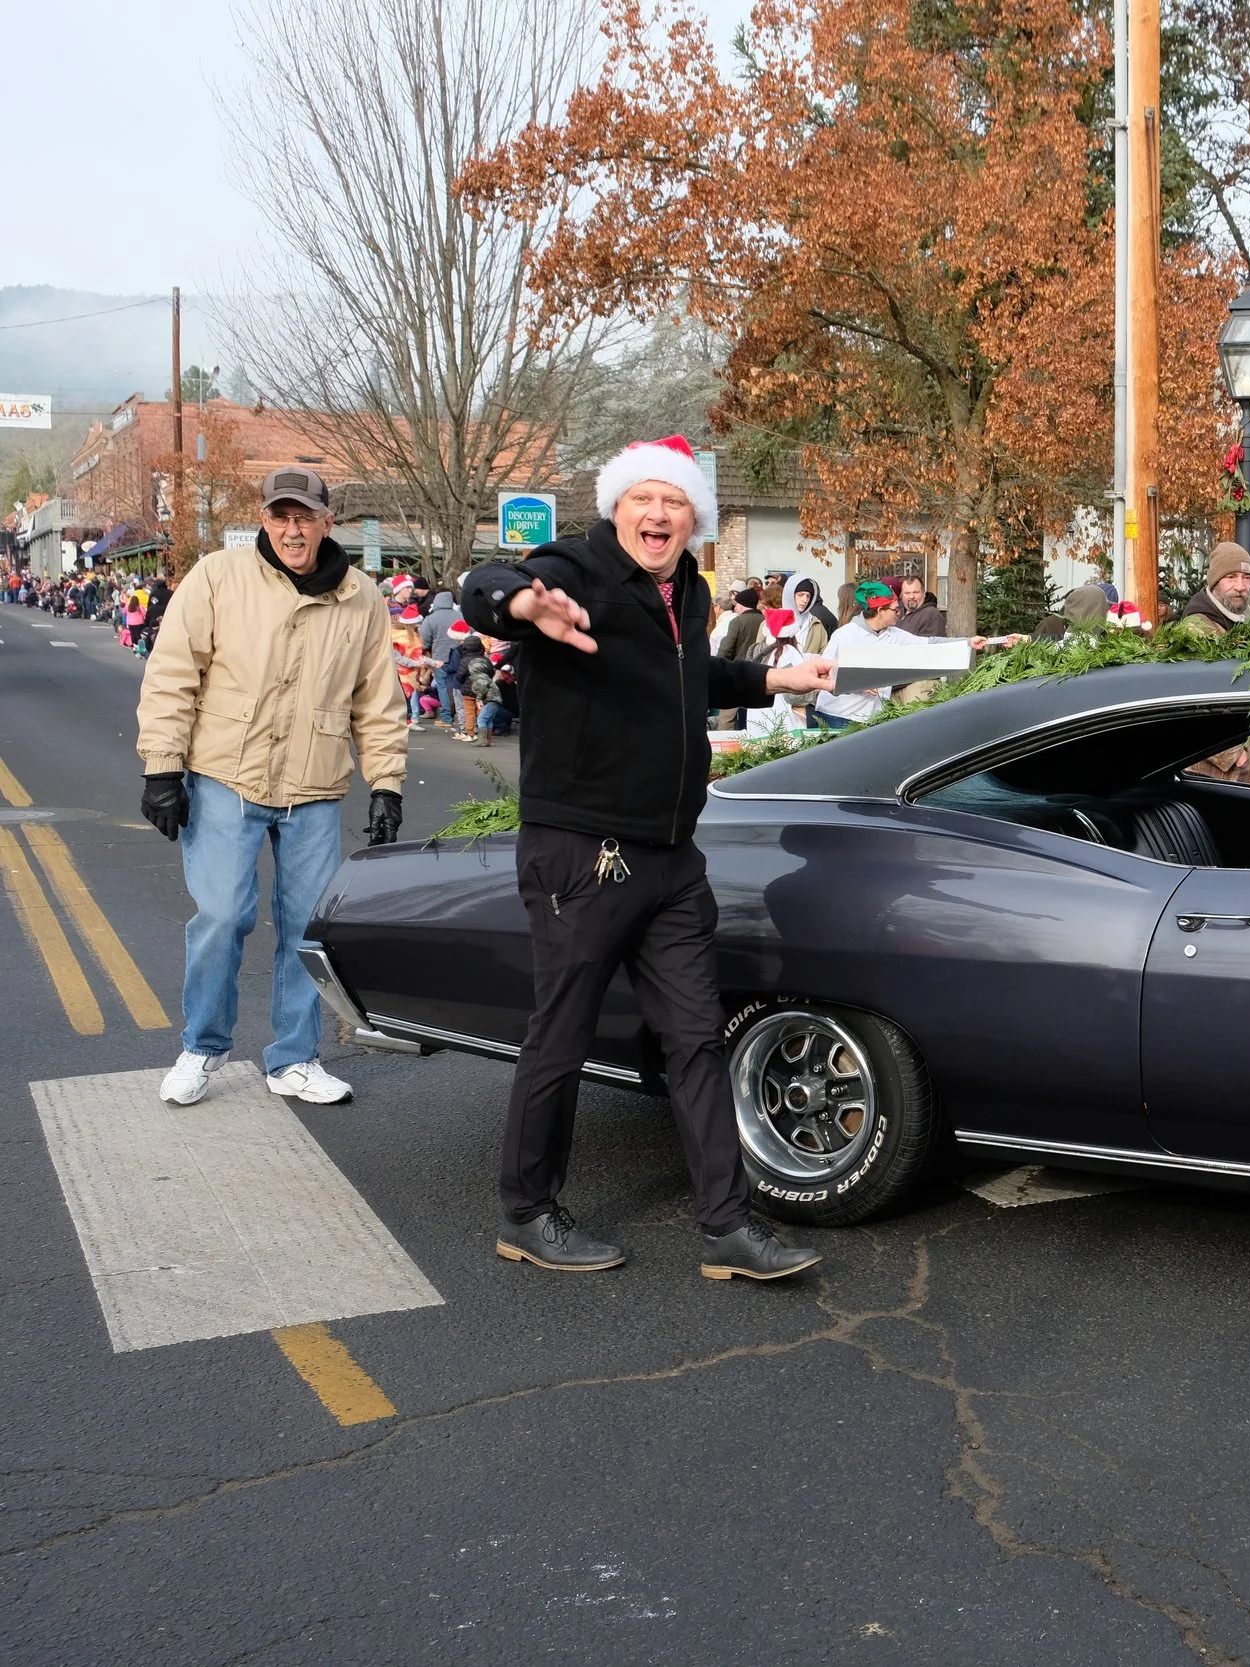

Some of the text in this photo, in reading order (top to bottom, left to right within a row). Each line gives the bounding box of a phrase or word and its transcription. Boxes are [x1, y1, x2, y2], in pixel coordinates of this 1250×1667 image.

[508, 511, 546, 521] DISCOVERY
[516, 521, 540, 530] DRIVE
[757, 1115, 888, 1202] COOPER COBRA
